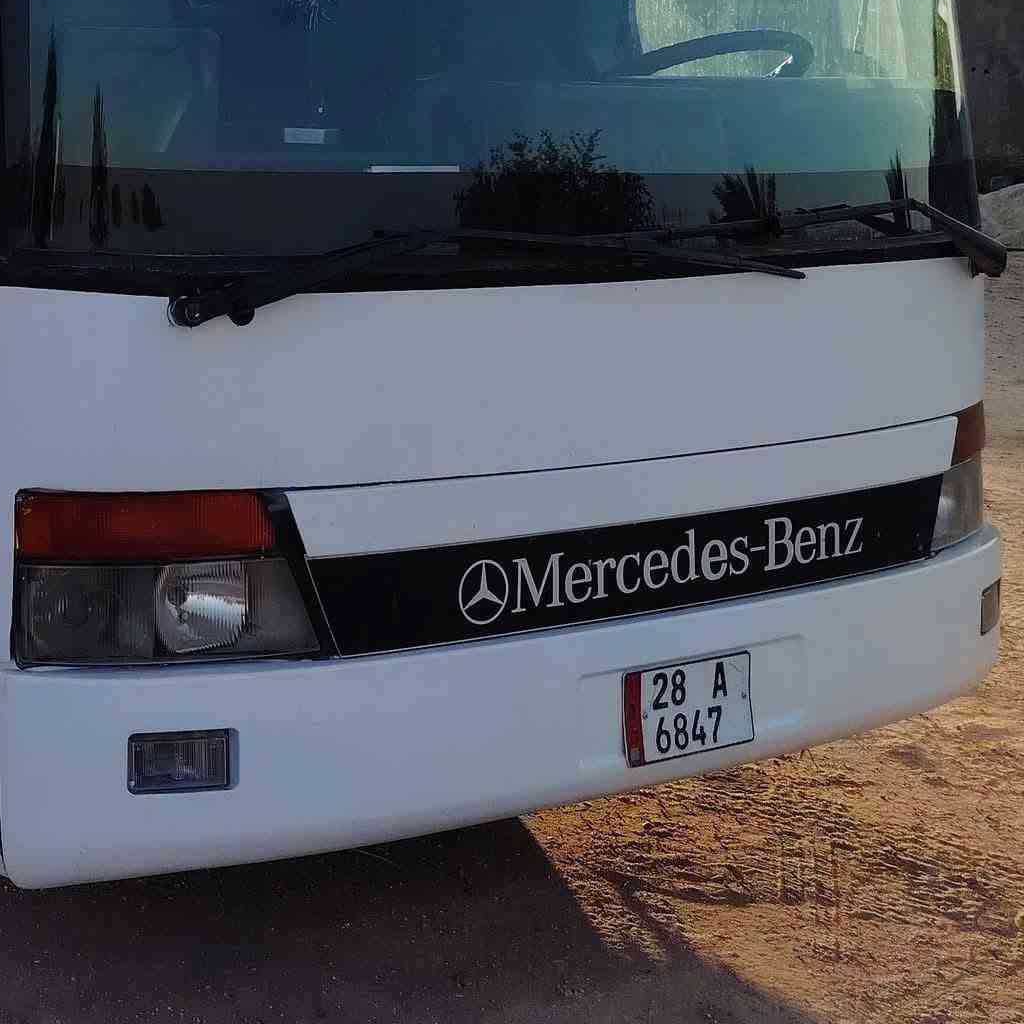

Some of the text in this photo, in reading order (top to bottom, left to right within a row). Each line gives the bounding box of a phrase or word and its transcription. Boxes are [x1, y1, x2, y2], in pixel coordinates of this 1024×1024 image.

[511, 517, 864, 614] Mercedes-Benz
[652, 661, 728, 710] 28 A
[655, 705, 723, 754] 6847
